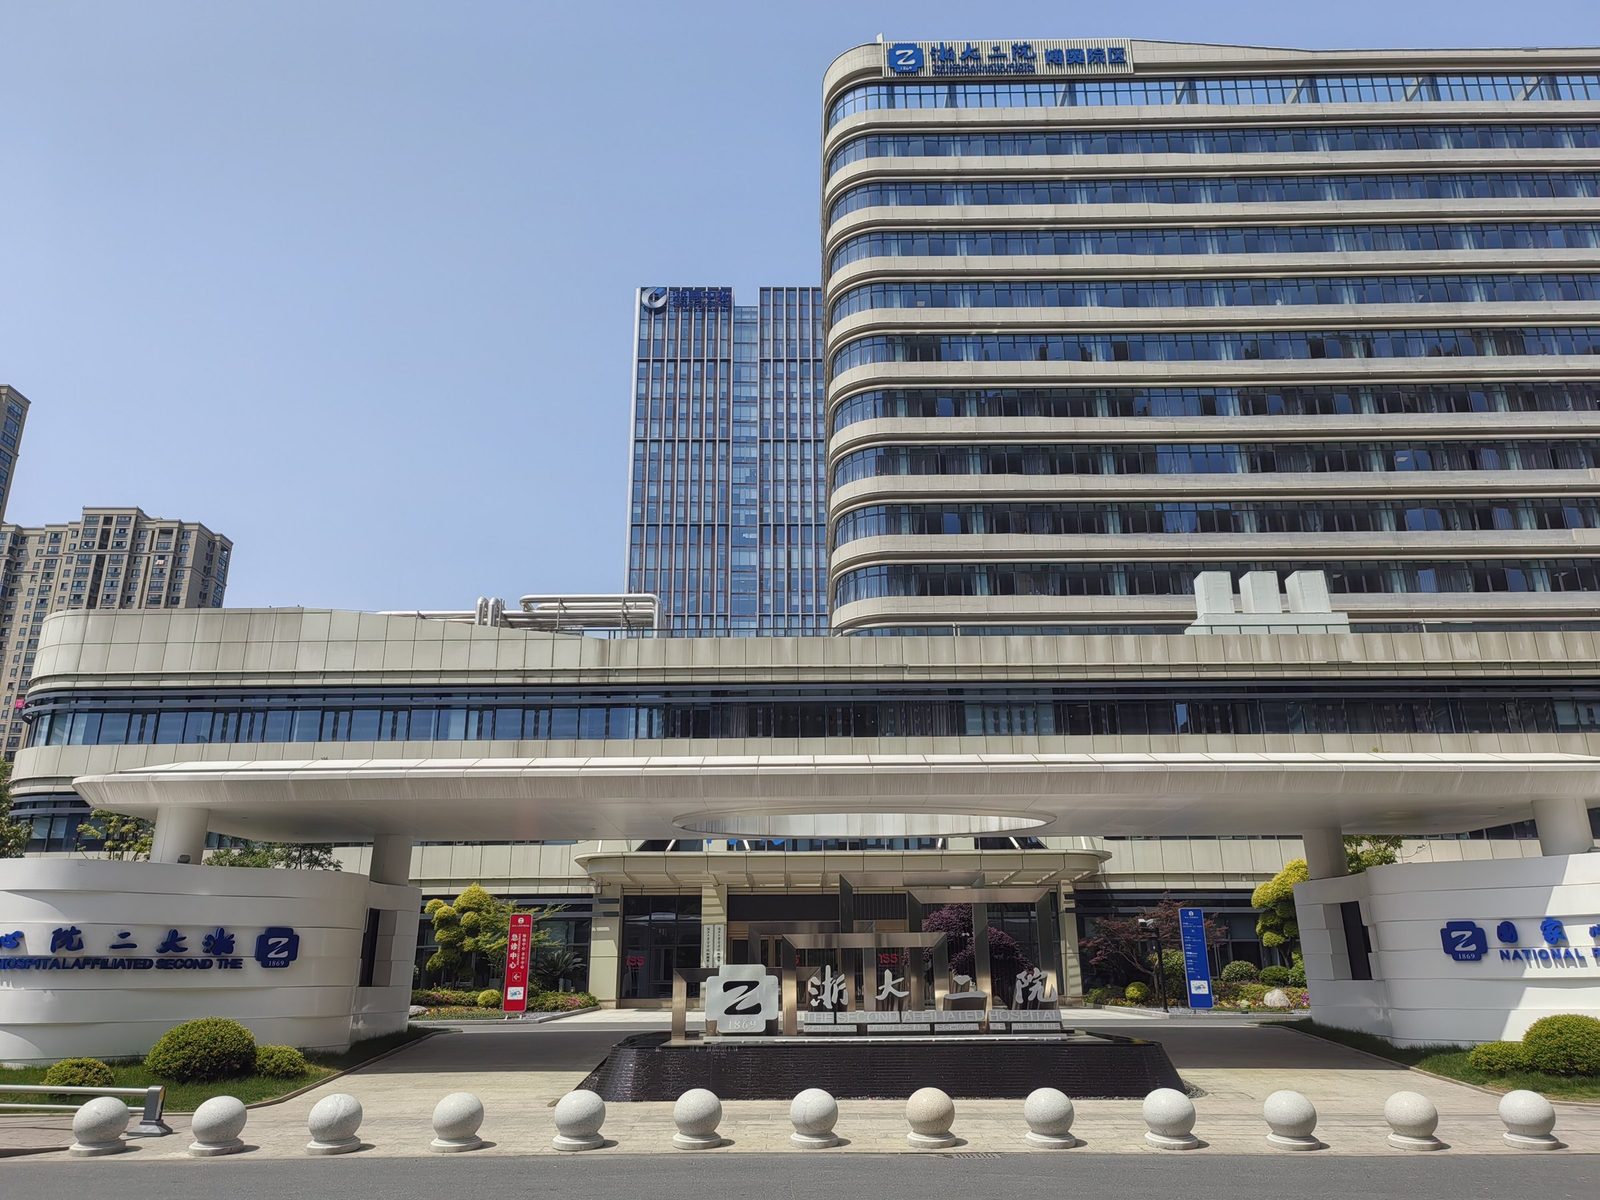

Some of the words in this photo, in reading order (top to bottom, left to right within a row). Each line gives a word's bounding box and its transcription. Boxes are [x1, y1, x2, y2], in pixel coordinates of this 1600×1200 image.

[1499, 948, 1586, 961] NATIONAL
[155, 958, 213, 969] SECOND
[216, 958, 243, 969] THE
[808, 965, 1058, 1009] 浙大二院
[807, 1012, 834, 1023] THE
[837, 1011, 900, 1022] SECOND
[902, 1011, 985, 1022] AFFILIATED
[988, 1010, 1060, 1021] HOSPITAL
